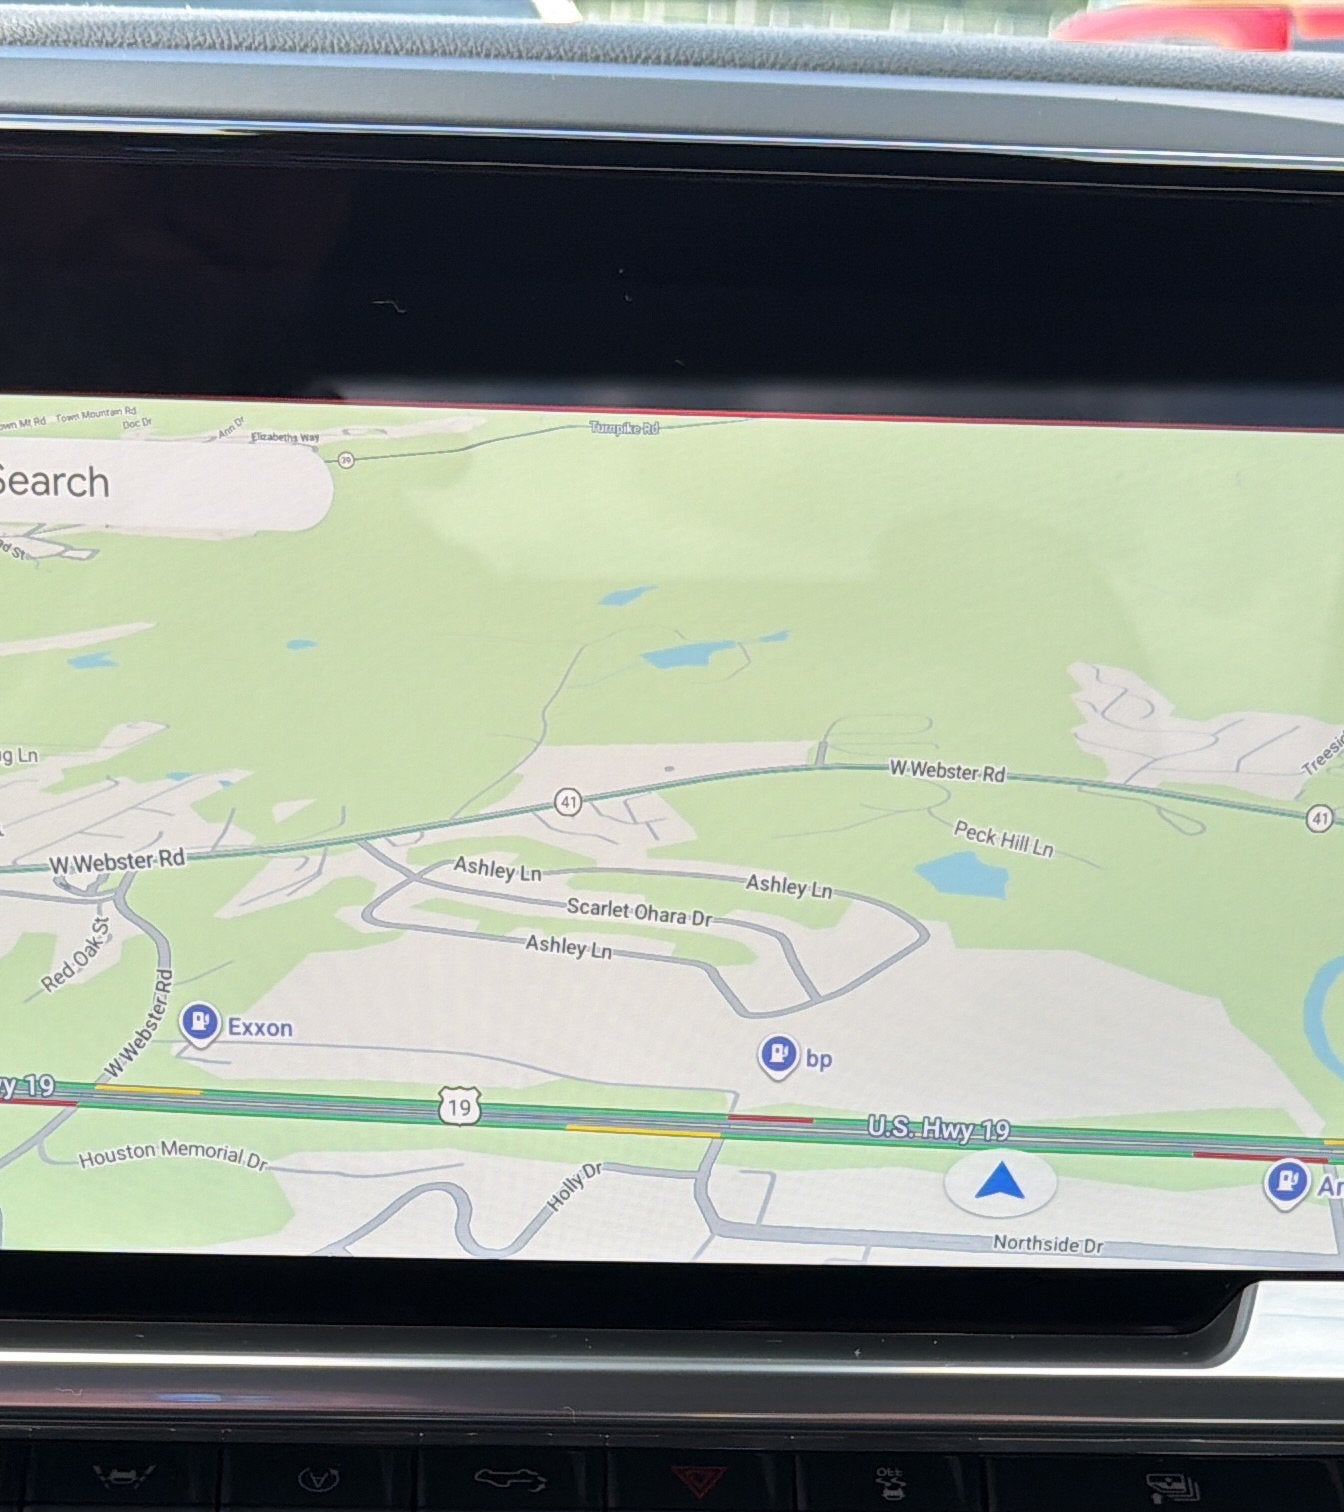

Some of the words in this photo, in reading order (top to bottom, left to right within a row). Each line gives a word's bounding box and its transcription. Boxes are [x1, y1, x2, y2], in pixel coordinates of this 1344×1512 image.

[18, 419, 33, 429] Mt
[34, 416, 47, 426] Rd
[56, 412, 80, 424] Town
[81, 408, 123, 421] Mountain
[124, 406, 137, 416] Rd
[122, 420, 141, 430] Doc
[142, 416, 153, 427] Dr
[218, 424, 236, 439] Ann
[233, 415, 245, 427] Dr
[300, 433, 320, 443] Way
[589, 420, 641, 435] Turnpike
[642, 422, 660, 435] Rd
[11, 546, 26, 560] St
[18, 747, 38, 764] Ln
[889, 759, 907, 776] W
[910, 761, 978, 782] Webster
[982, 766, 1007, 784] Rd
[560, 796, 578, 810] 41
[1311, 811, 1330, 826] 41
[953, 819, 997, 846] Peck
[999, 830, 1030, 854] Hill
[1032, 840, 1056, 858] Ln
[49, 856, 73, 874] W
[73, 853, 154, 873] Webster
[159, 848, 186, 866] Rd
[453, 855, 515, 885] Ashley
[520, 864, 543, 882] Ln
[746, 874, 807, 898] Ashley
[812, 882, 833, 900] Ln
[567, 897, 630, 920] Scarlet
[634, 903, 687, 926] Ohara
[692, 911, 714, 928] Dr
[41, 965, 76, 993] Red
[73, 935, 104, 969] Oak
[92, 915, 109, 939] St
[525, 934, 587, 960] Ashley
[591, 942, 613, 960] Ln
[104, 1055, 126, 1079] W
[121, 993, 169, 1063] Webster
[156, 968, 173, 994] Rd
[228, 1017, 293, 1038] Exxon
[805, 1048, 833, 1073] bp
[26, 1075, 56, 1097] 19
[447, 1099, 471, 1117] 19
[867, 1114, 916, 1139] U.S.
[921, 1117, 975, 1144] Hwy
[982, 1119, 1011, 1142] 19
[78, 1142, 156, 1170] Houston
[160, 1140, 244, 1165] Memorial
[246, 1153, 269, 1173] Dr
[547, 1170, 586, 1213] Holly
[581, 1161, 604, 1180] Dr
[994, 1234, 1080, 1253] Northside
[1084, 1238, 1105, 1254] Dr
